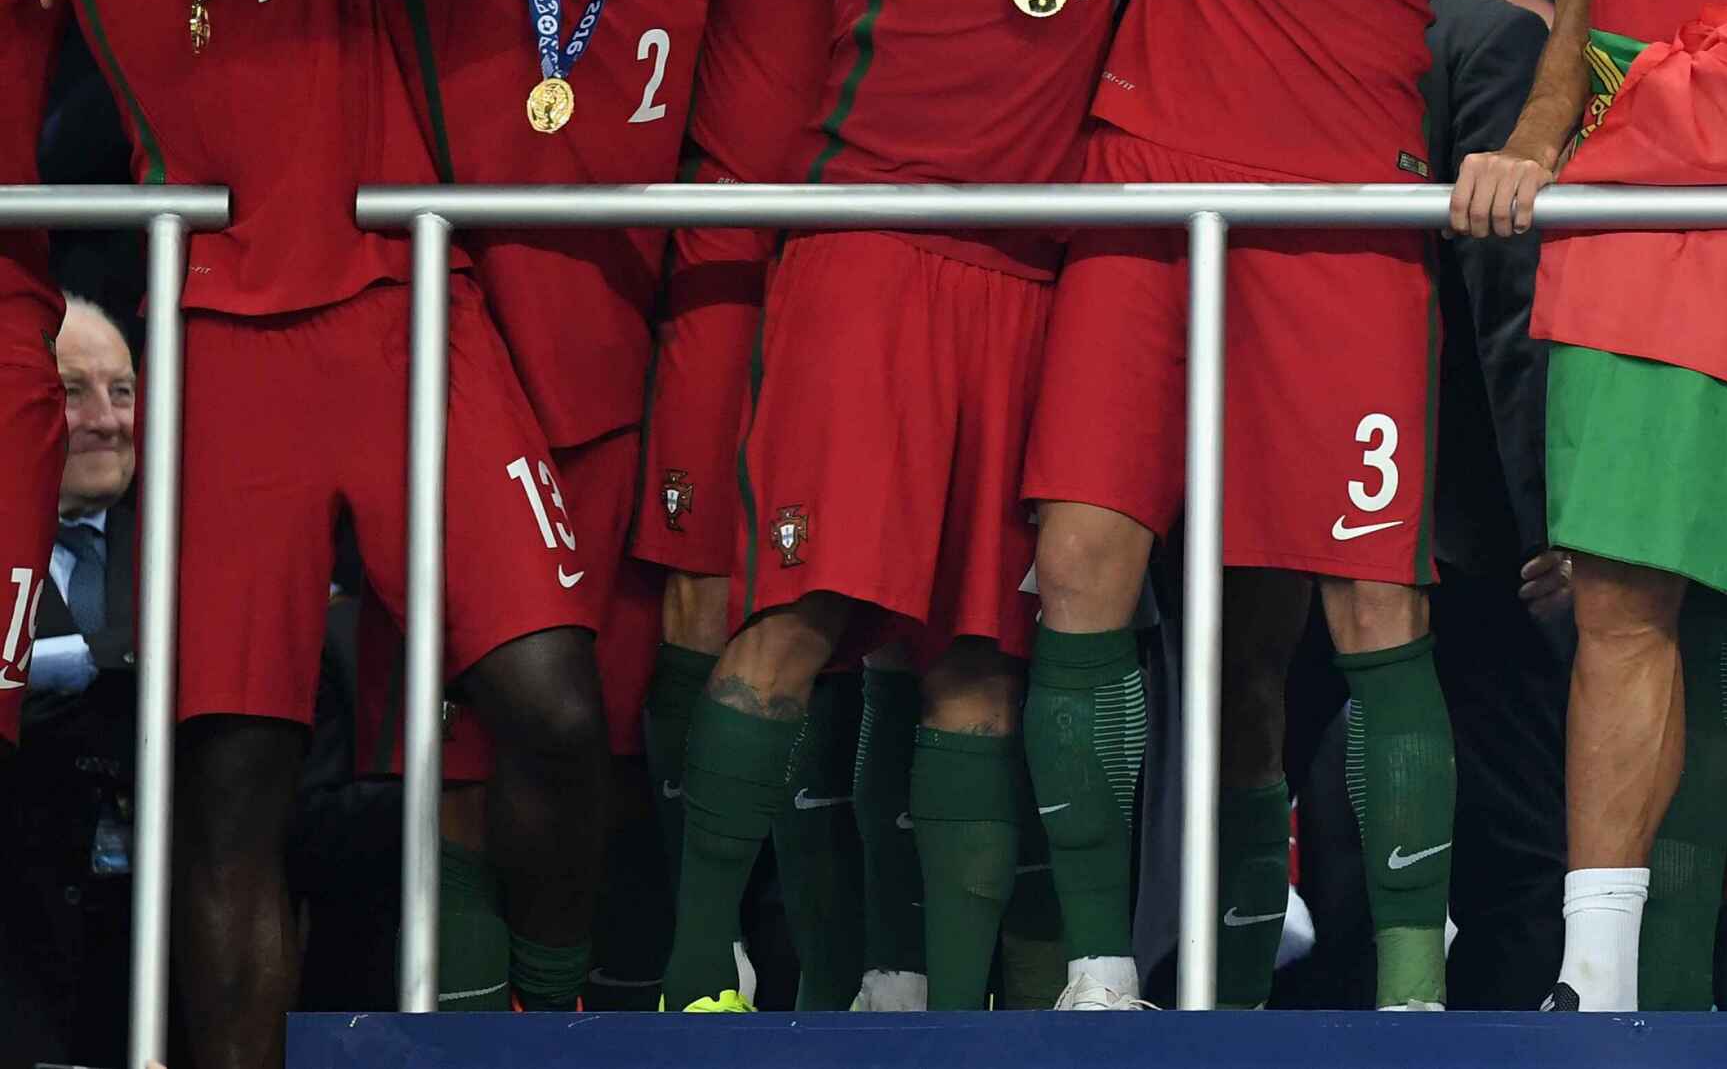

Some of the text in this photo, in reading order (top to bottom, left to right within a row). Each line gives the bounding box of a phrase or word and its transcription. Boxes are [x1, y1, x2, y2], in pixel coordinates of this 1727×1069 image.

[565, 0, 601, 57] 2016
[626, 28, 671, 124] 2
[506, 455, 579, 552] 13
[1346, 413, 1400, 512] 3
